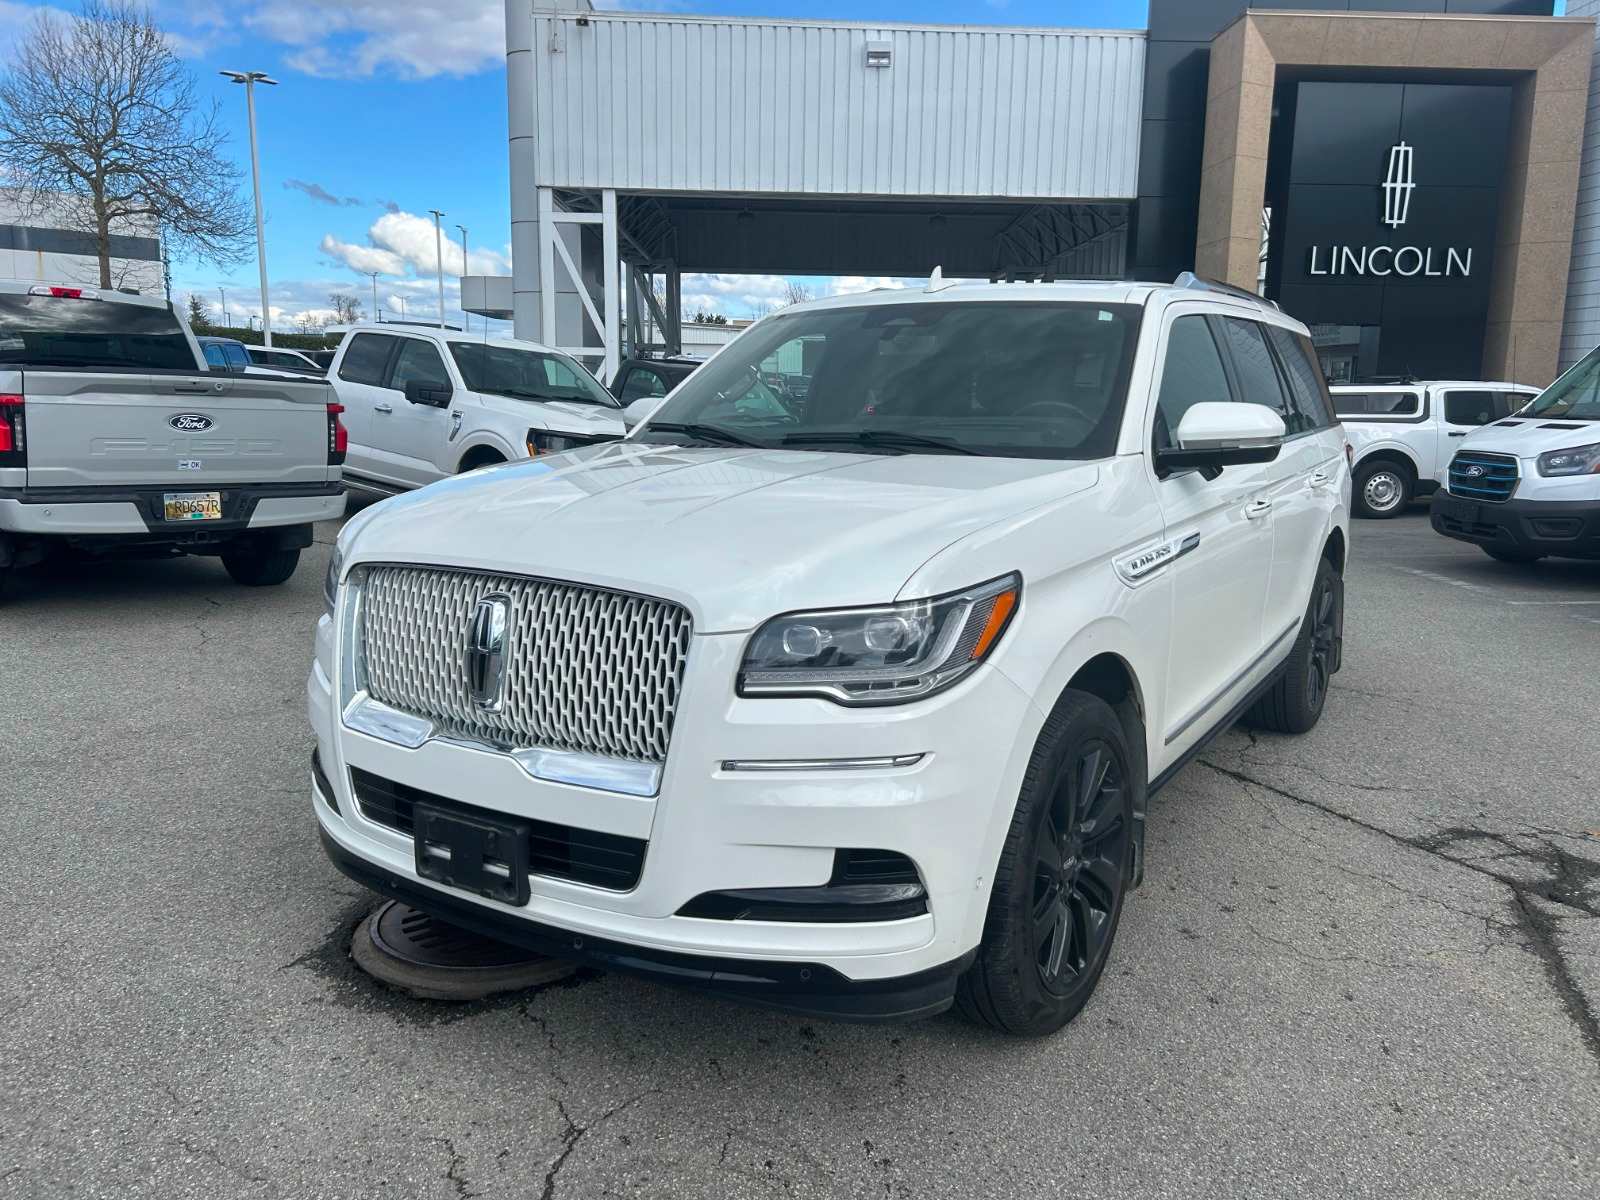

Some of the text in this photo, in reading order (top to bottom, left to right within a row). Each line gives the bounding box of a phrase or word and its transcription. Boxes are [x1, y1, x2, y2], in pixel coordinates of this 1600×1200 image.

[1310, 245, 1472, 276] LINCOLN
[177, 416, 206, 429] Ford
[90, 438, 284, 456] F-150
[191, 461, 200, 470] OK
